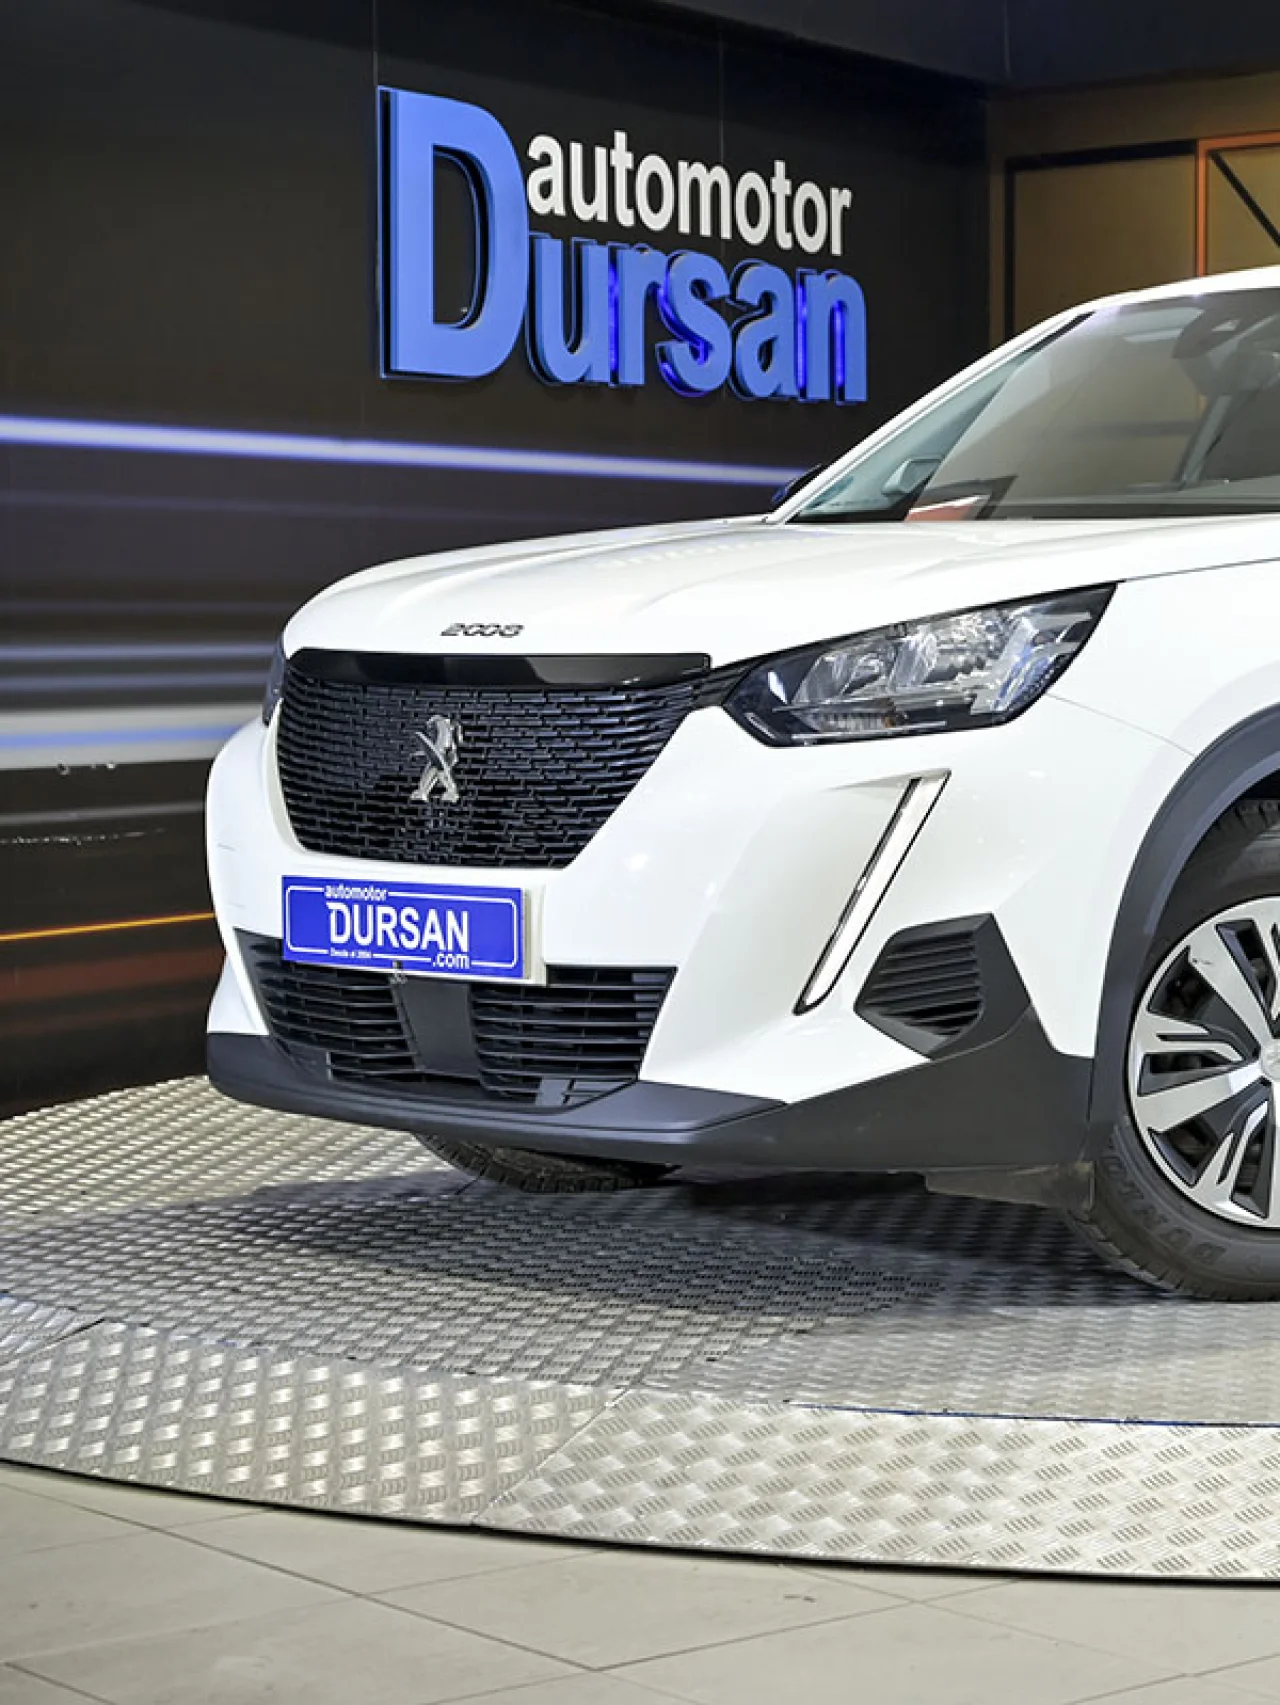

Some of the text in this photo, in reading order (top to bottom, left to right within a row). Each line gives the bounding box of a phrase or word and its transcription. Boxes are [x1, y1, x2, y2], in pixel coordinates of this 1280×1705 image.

[526, 129, 852, 256] automotor
[377, 85, 868, 405] Dursan
[324, 883, 388, 901] automotor
[325, 901, 469, 952] DURSAN
[432, 953, 470, 969] .com
